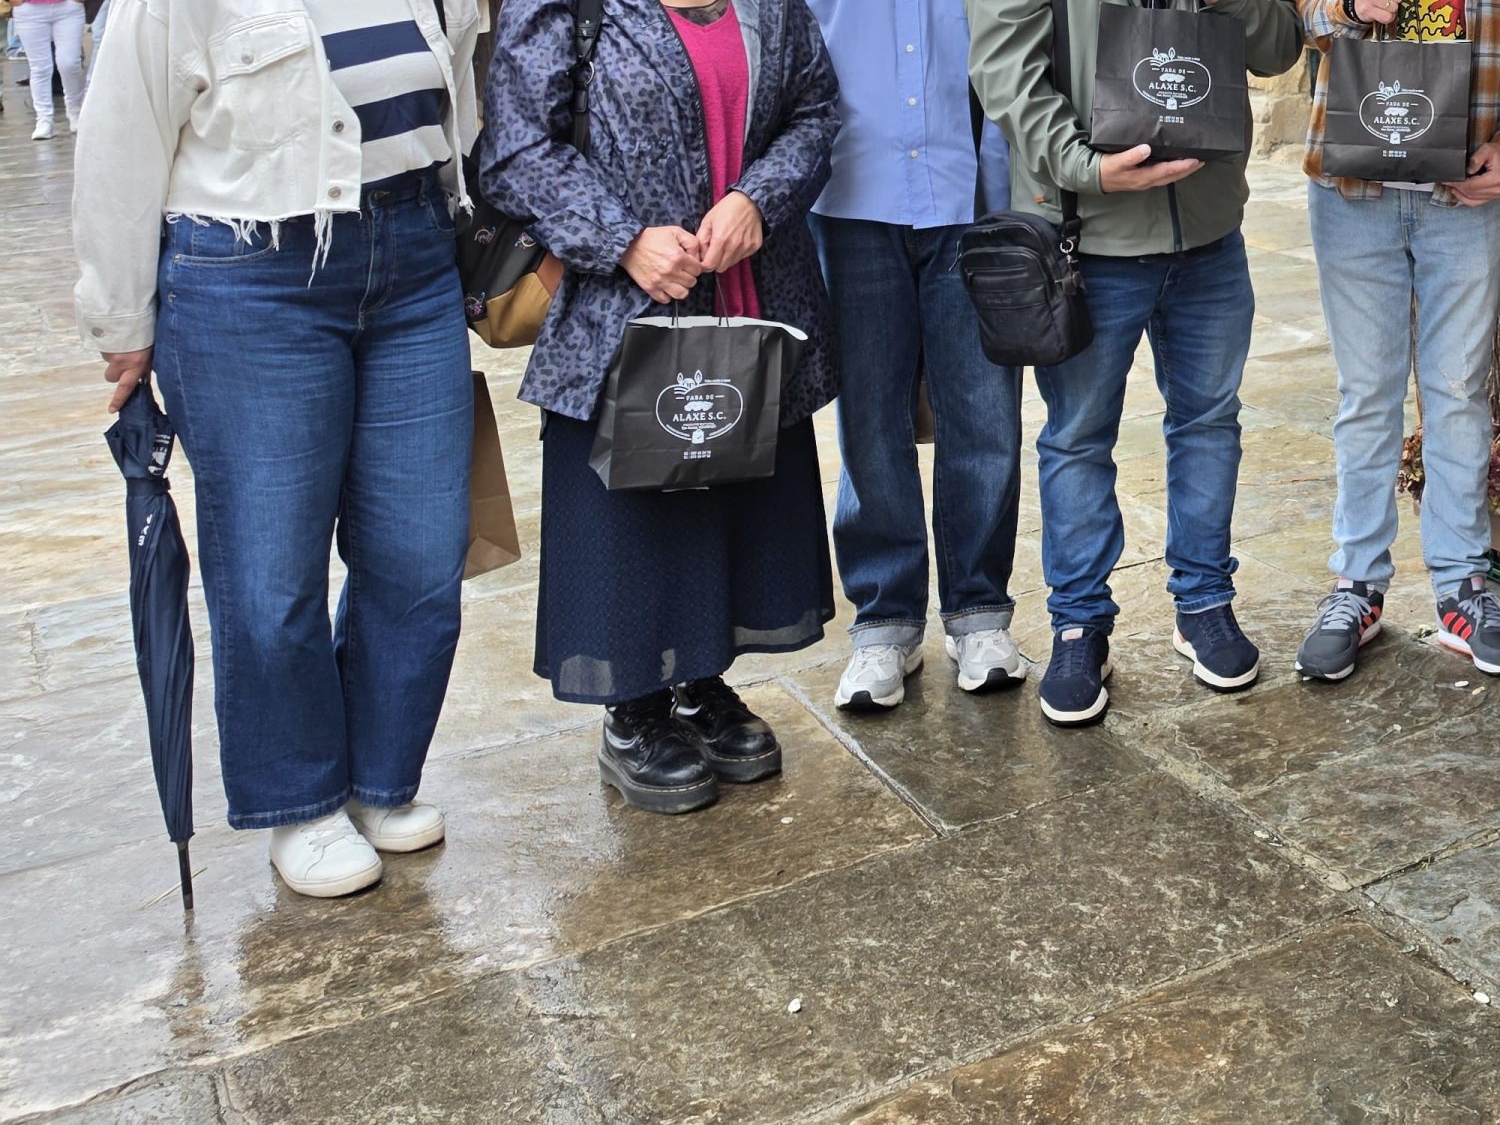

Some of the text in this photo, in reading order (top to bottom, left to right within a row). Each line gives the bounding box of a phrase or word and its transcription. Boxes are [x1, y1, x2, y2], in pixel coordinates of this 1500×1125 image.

[1148, 81, 1197, 93] ALAXE S.C.
[1373, 116, 1420, 125] ALAXE S.C.
[672, 411, 727, 422] ALAXE S.C.
